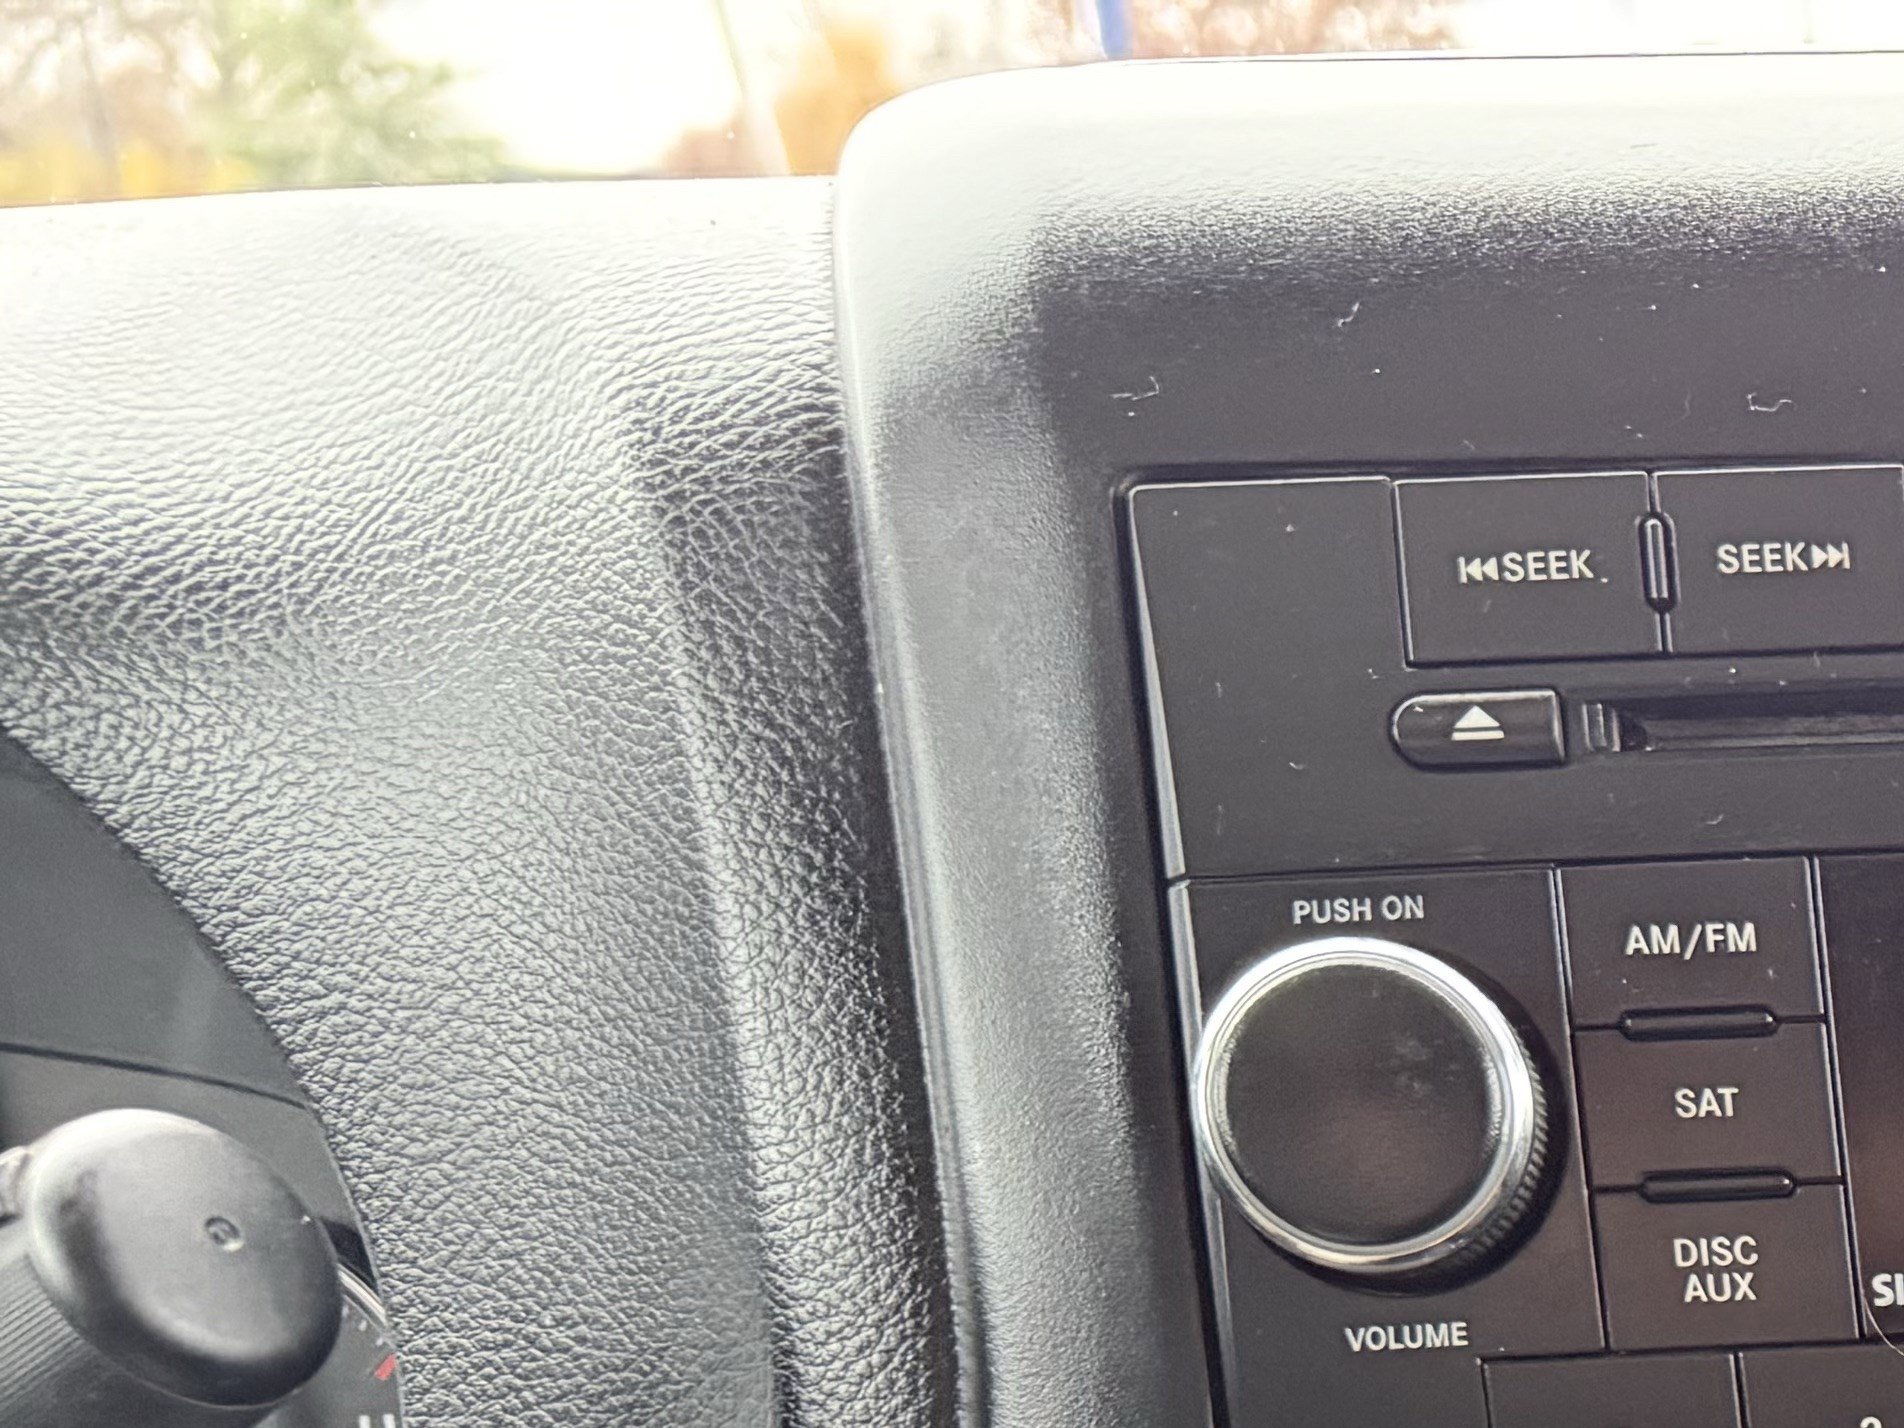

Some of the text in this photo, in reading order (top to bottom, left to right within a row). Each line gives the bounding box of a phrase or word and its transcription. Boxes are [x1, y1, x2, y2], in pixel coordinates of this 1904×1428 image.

[1502, 548, 1594, 583] SEEK
[1716, 541, 1808, 575] SEEK
[1292, 894, 1425, 925] PUSH ON
[1625, 921, 1757, 961] AM/FM
[1674, 1086, 1739, 1119] SAT
[1673, 1235, 1759, 1268] DISC
[1684, 1271, 1757, 1303] AUX
[1344, 1321, 1469, 1352] VOLUME
